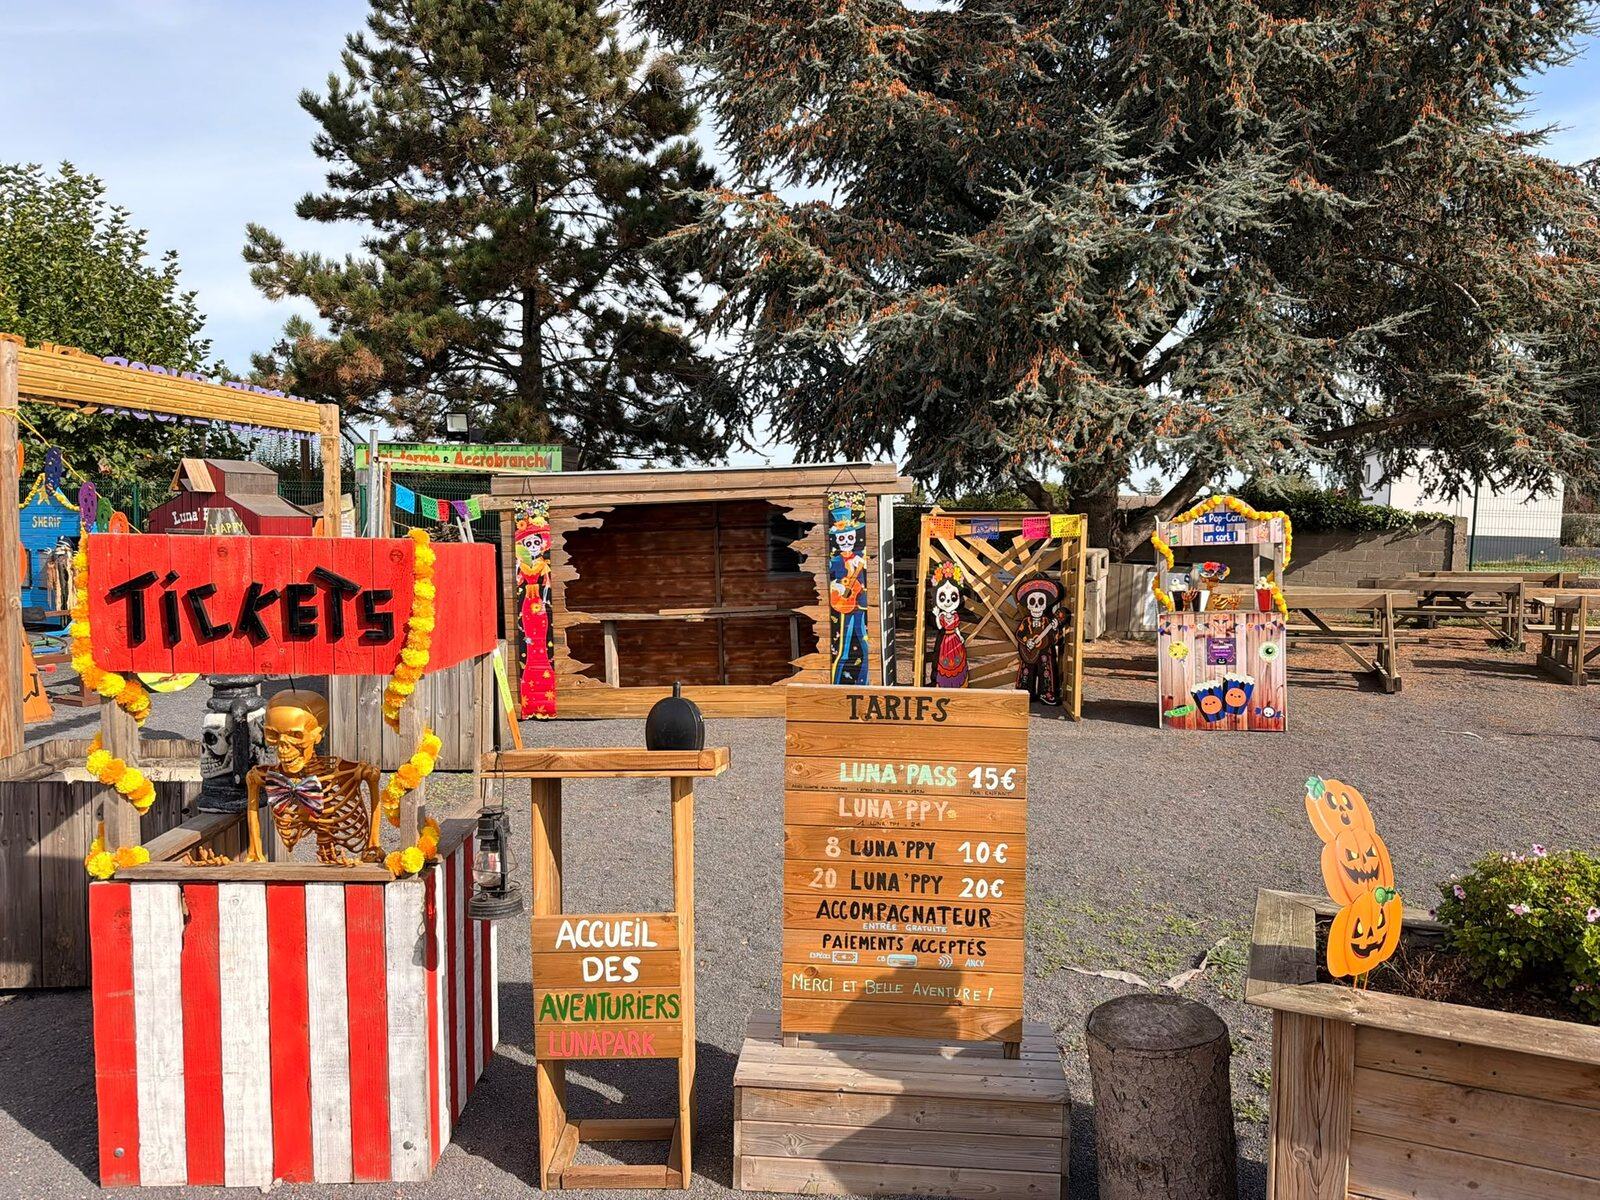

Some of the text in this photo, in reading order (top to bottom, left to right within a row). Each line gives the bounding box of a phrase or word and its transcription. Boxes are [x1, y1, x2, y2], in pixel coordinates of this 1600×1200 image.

[31, 515, 62, 529] SHERIF
[210, 521, 243, 534] HAPPY
[1204, 534, 1214, 542] un
[1215, 532, 1231, 542] sort
[846, 694, 950, 722] TARIFS
[968, 766, 1017, 790] 15€
[825, 836, 841, 858] 8
[957, 841, 1009, 864] 10€
[808, 867, 837, 889] 20
[958, 877, 1005, 899] 20€
[816, 899, 991, 928] ACCOMPAGNATEUR
[911, 938, 987, 957] ACCEPTÉS
[582, 955, 641, 983] DES
[843, 980, 858, 993] ET
[865, 979, 904, 995] BELLE
[912, 982, 982, 1001] AVENTURE
[548, 1029, 657, 1057] LUNAPARK
